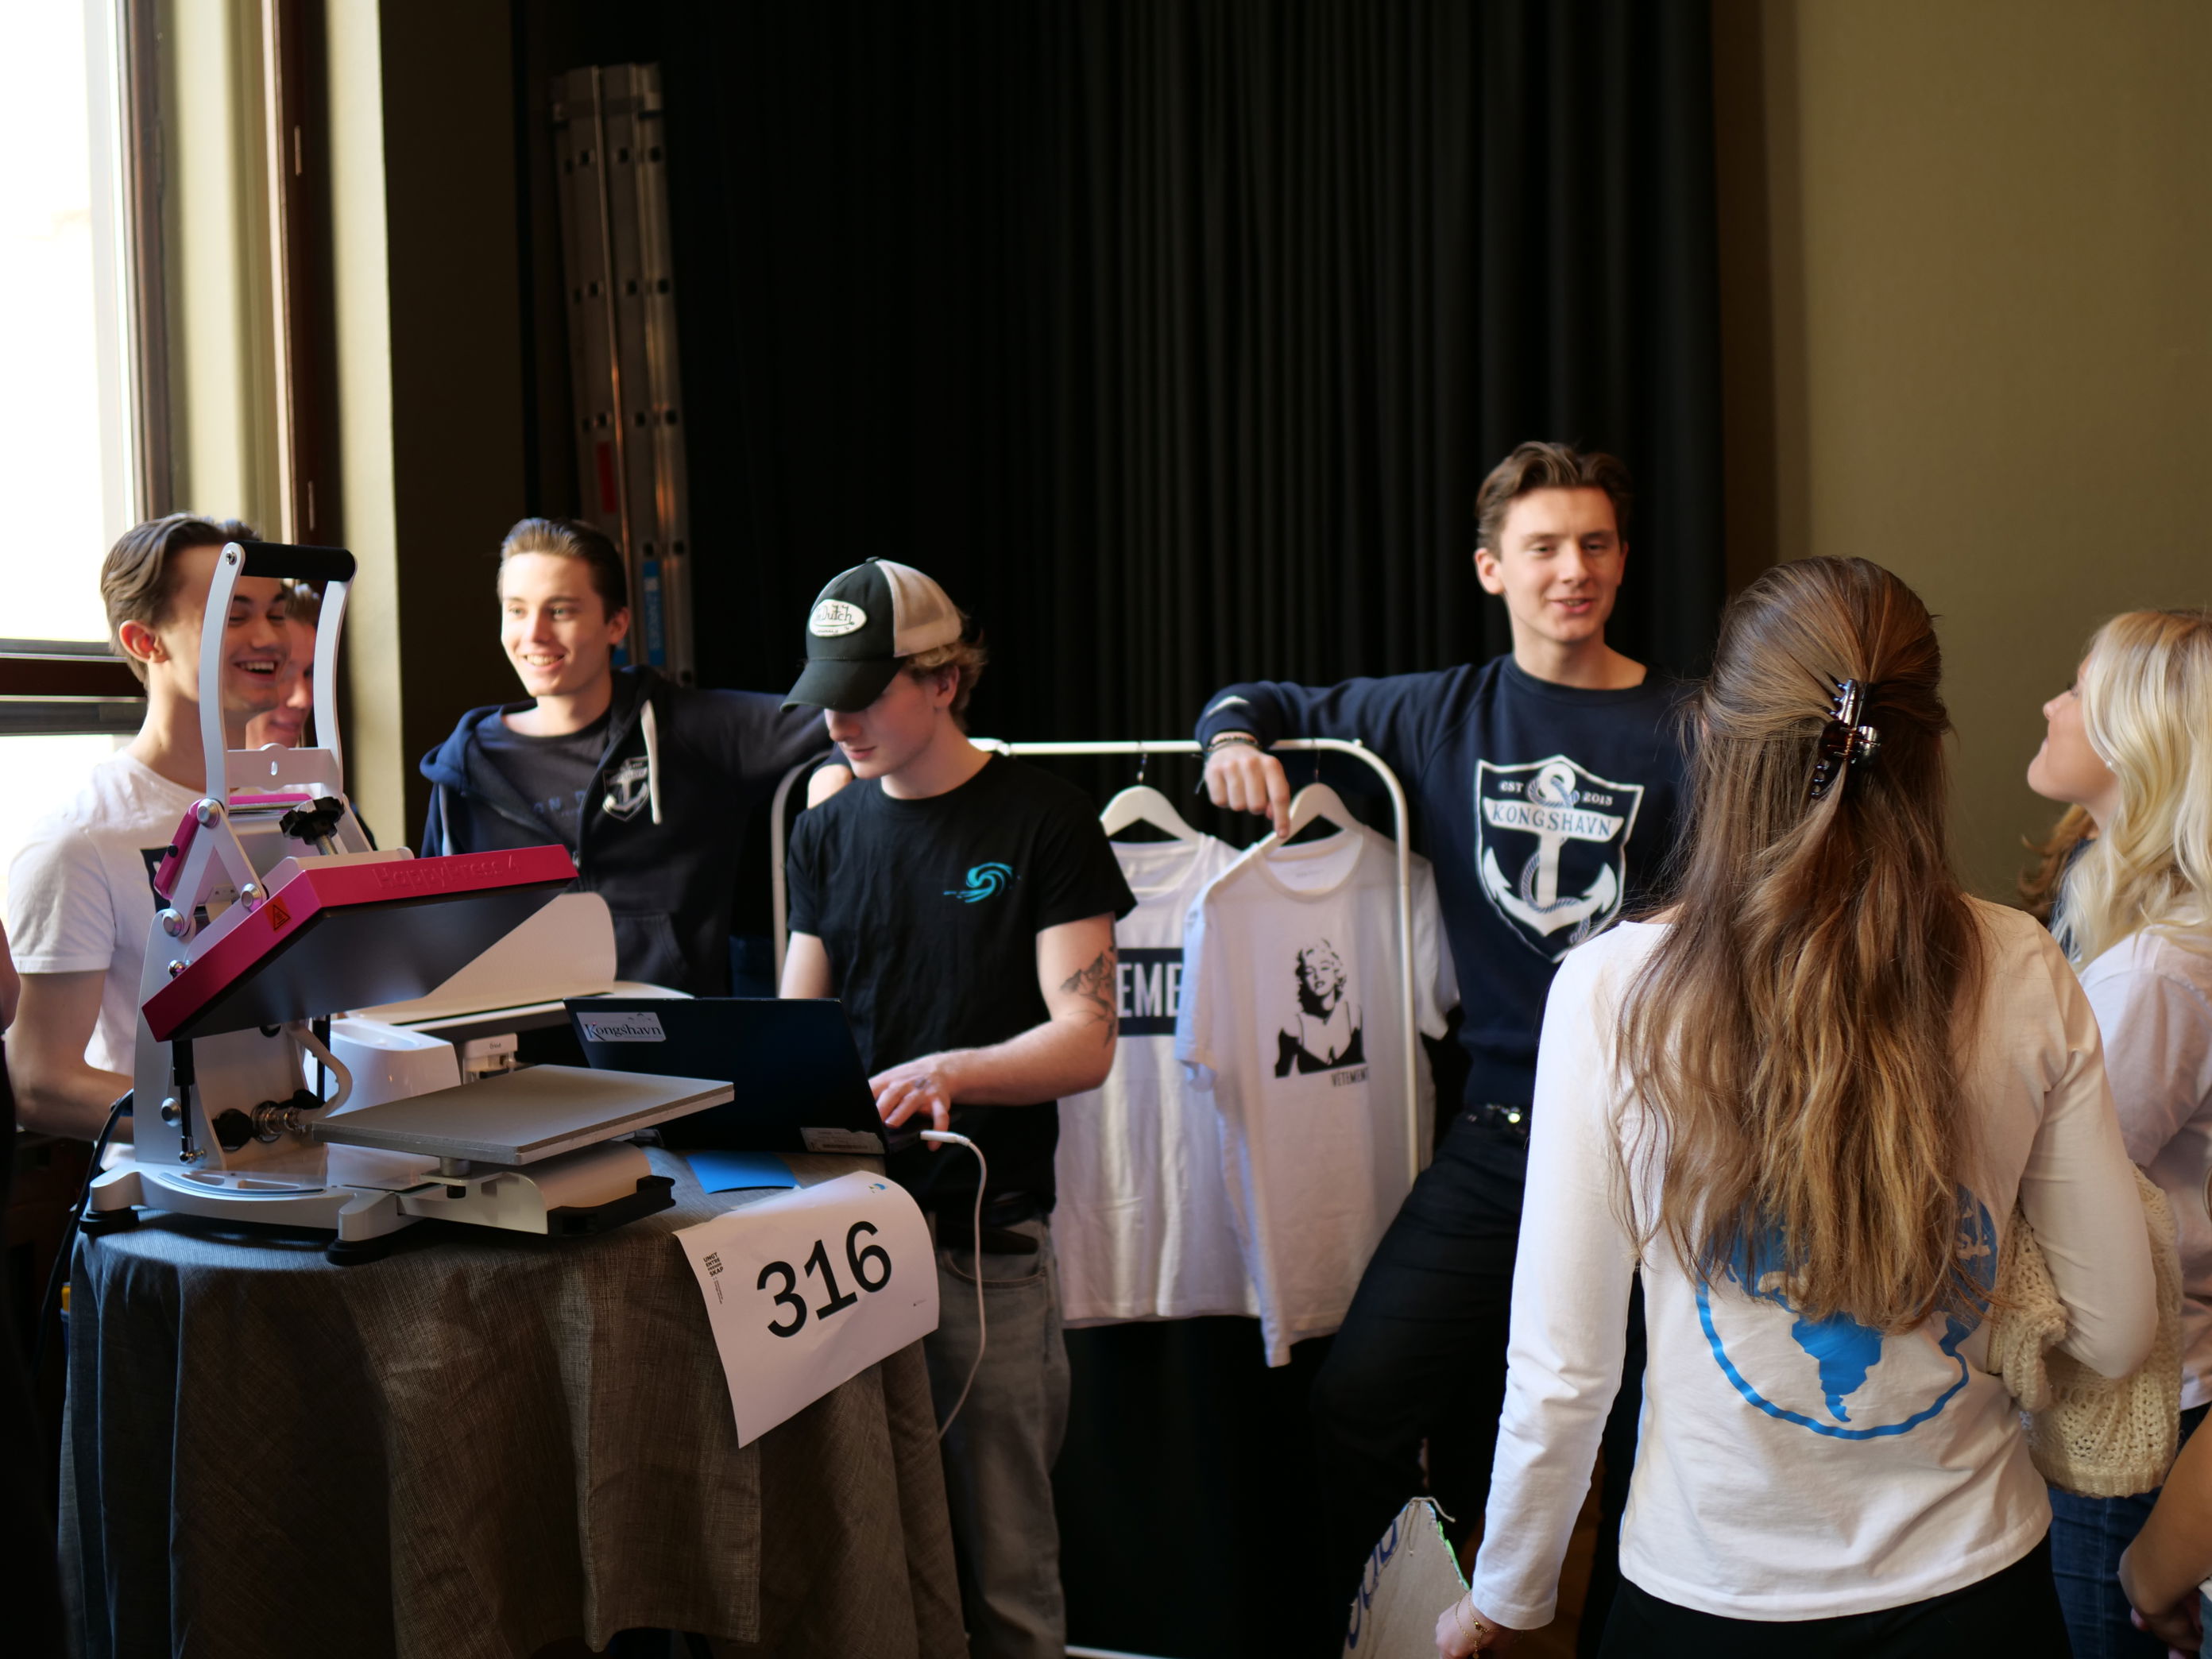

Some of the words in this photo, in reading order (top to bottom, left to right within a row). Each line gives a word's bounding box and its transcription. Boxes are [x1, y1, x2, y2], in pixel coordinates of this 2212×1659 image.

[1493, 803, 1612, 837] KONGSHAVN
[585, 1022, 662, 1042] Kongshavn
[703, 1251, 718, 1263] UNGT
[706, 1257, 721, 1268] ENTRE
[709, 1266, 724, 1277] SKAP
[756, 1220, 892, 1338] 316
